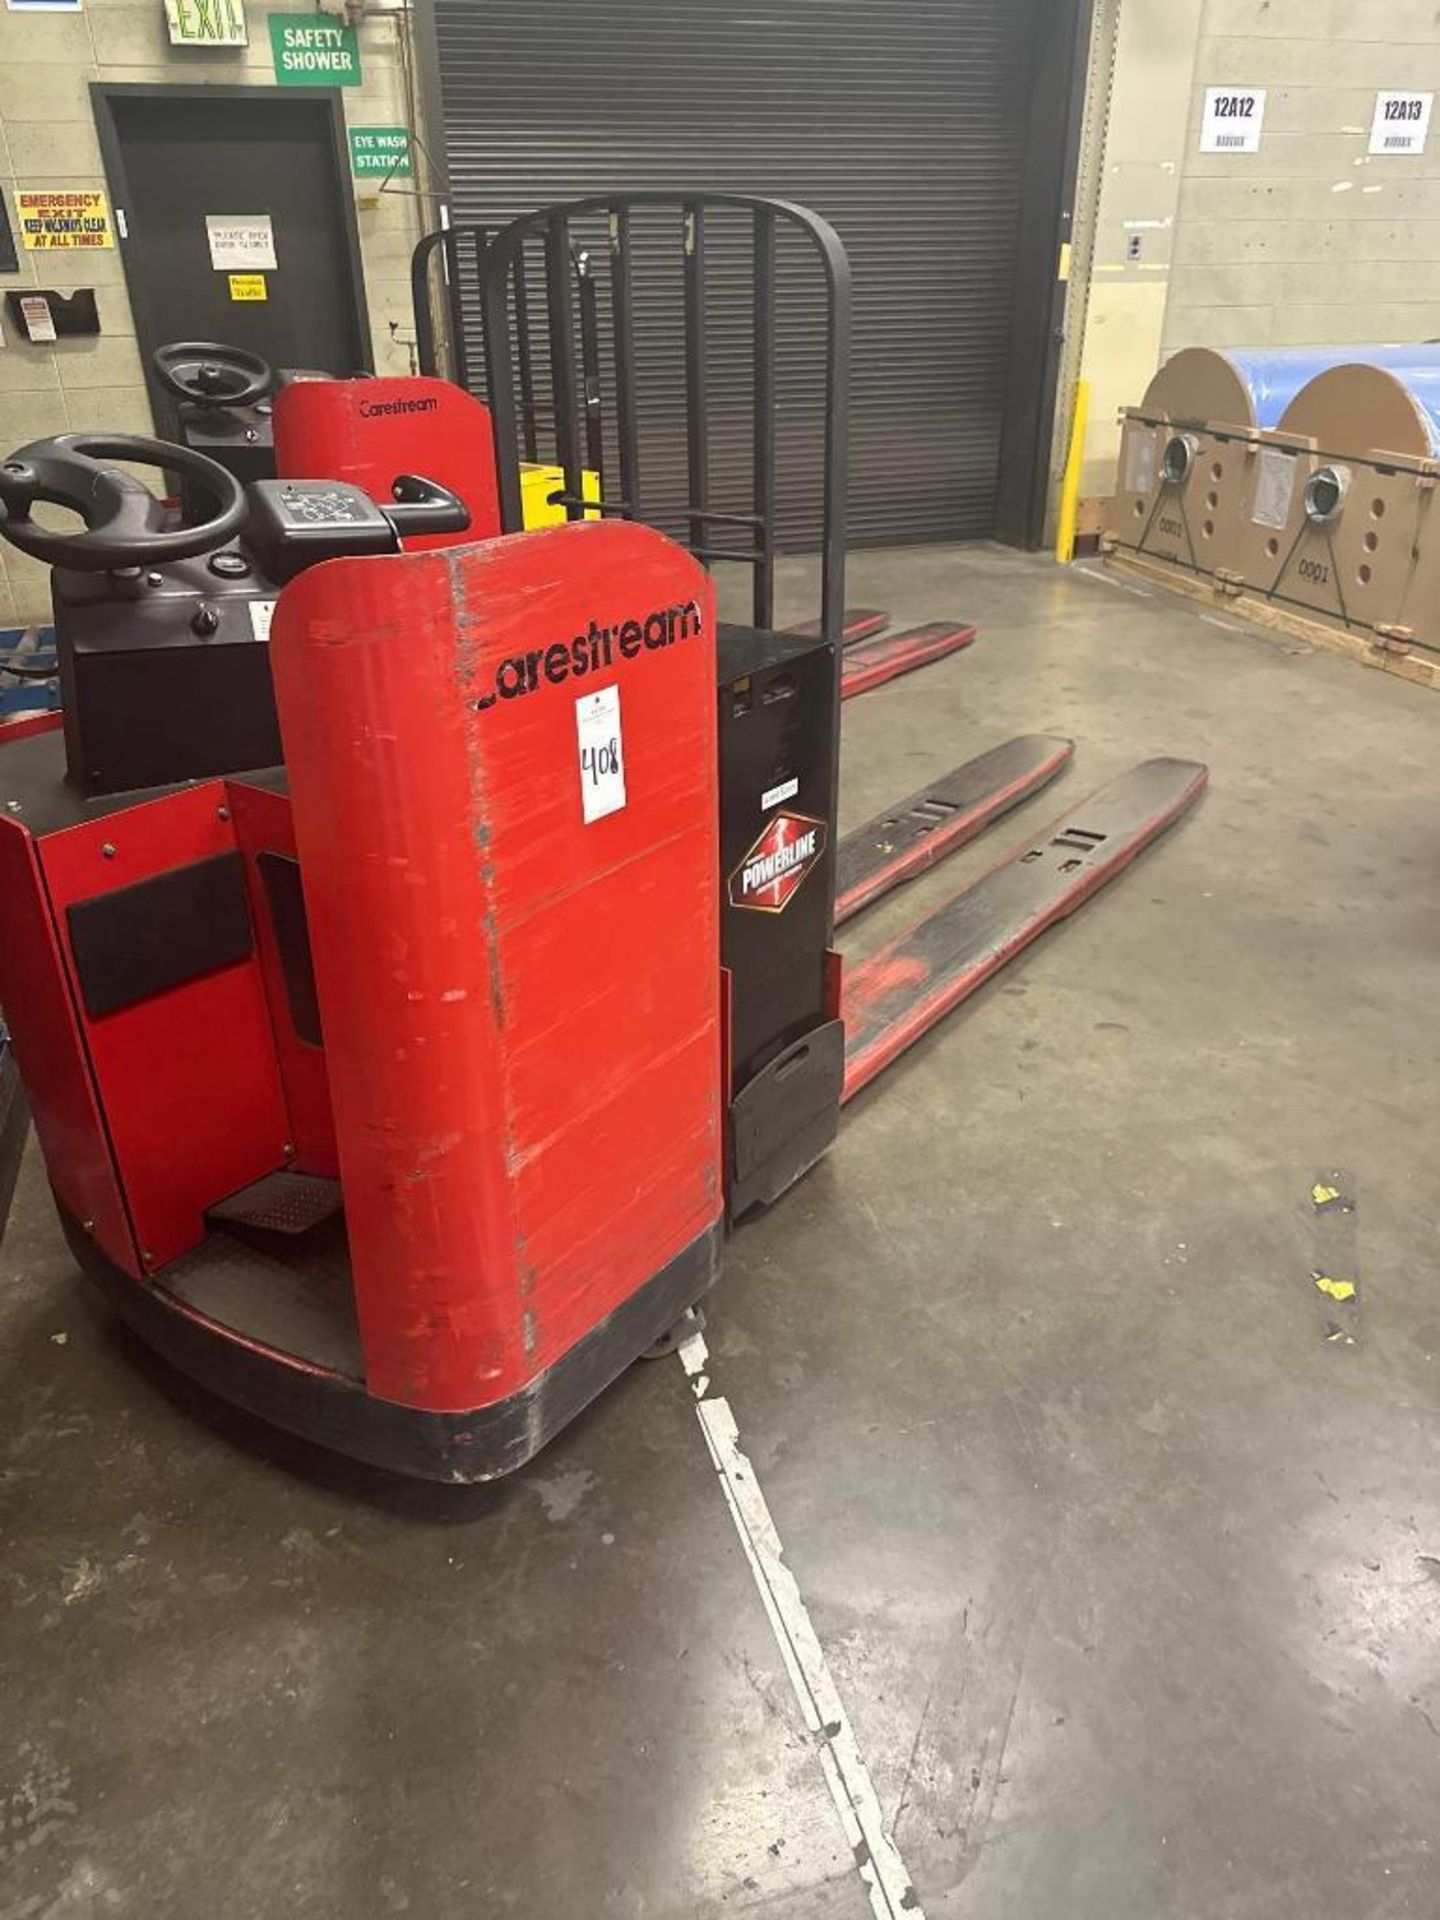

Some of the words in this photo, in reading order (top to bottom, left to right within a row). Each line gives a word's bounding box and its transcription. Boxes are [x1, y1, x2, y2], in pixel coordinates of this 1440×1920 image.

[284, 28, 343, 48] SAFETY
[282, 51, 353, 70] SHOWER
[1214, 96, 1255, 117] 12A12
[1384, 100, 1422, 120] 12A13
[354, 136, 375, 149] EYE
[378, 136, 407, 149] WASH
[356, 155, 409, 168] STATION
[20, 194, 101, 208] EMERGENCY
[37, 209, 87, 218] EXIT
[34, 235, 47, 248] AT
[50, 235, 70, 247] ALL
[71, 234, 104, 246] TIMES
[359, 397, 438, 418] Carestream
[474, 600, 701, 711] arestream
[582, 737, 619, 786] 408
[742, 829, 817, 896] POWERLINE
